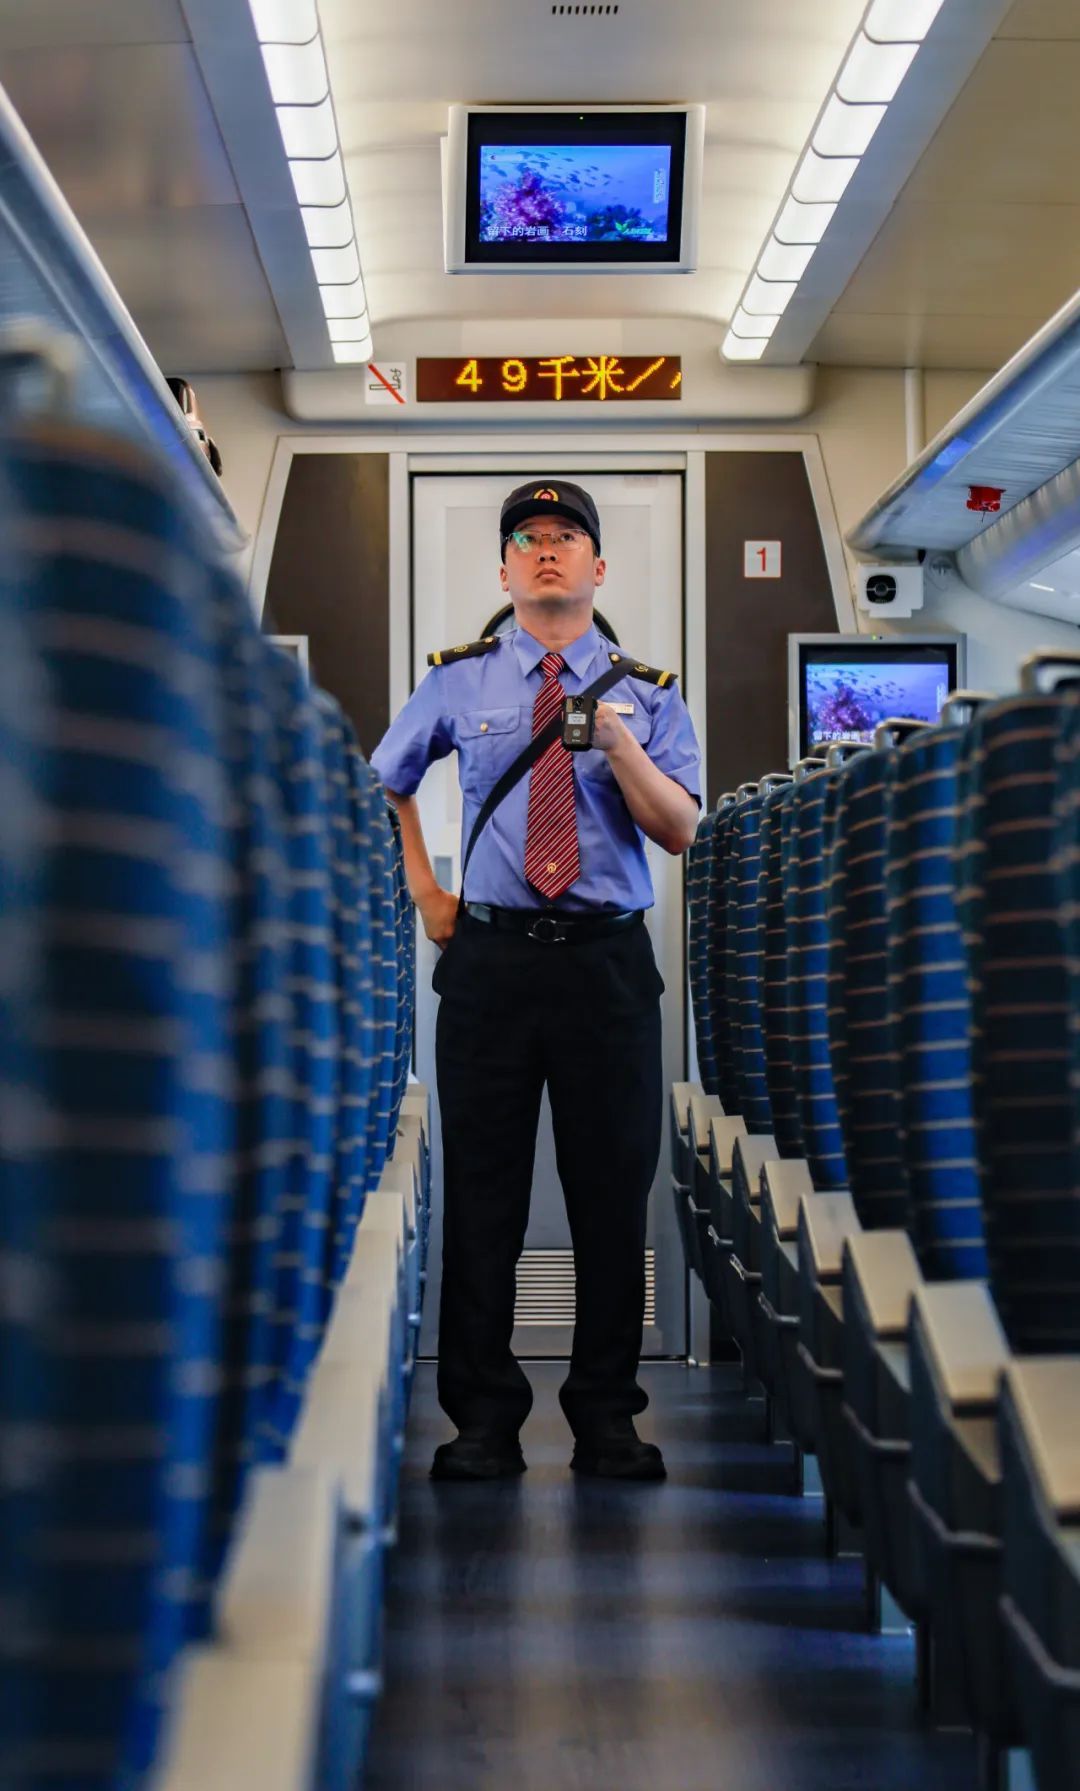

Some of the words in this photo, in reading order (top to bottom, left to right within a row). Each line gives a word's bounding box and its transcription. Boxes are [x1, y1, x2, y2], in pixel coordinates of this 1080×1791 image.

[487, 225, 549, 237] 留下的岩画
[561, 225, 587, 237] 石刻
[455, 355, 682, 400] 49千米/
[756, 547, 767, 572] 1
